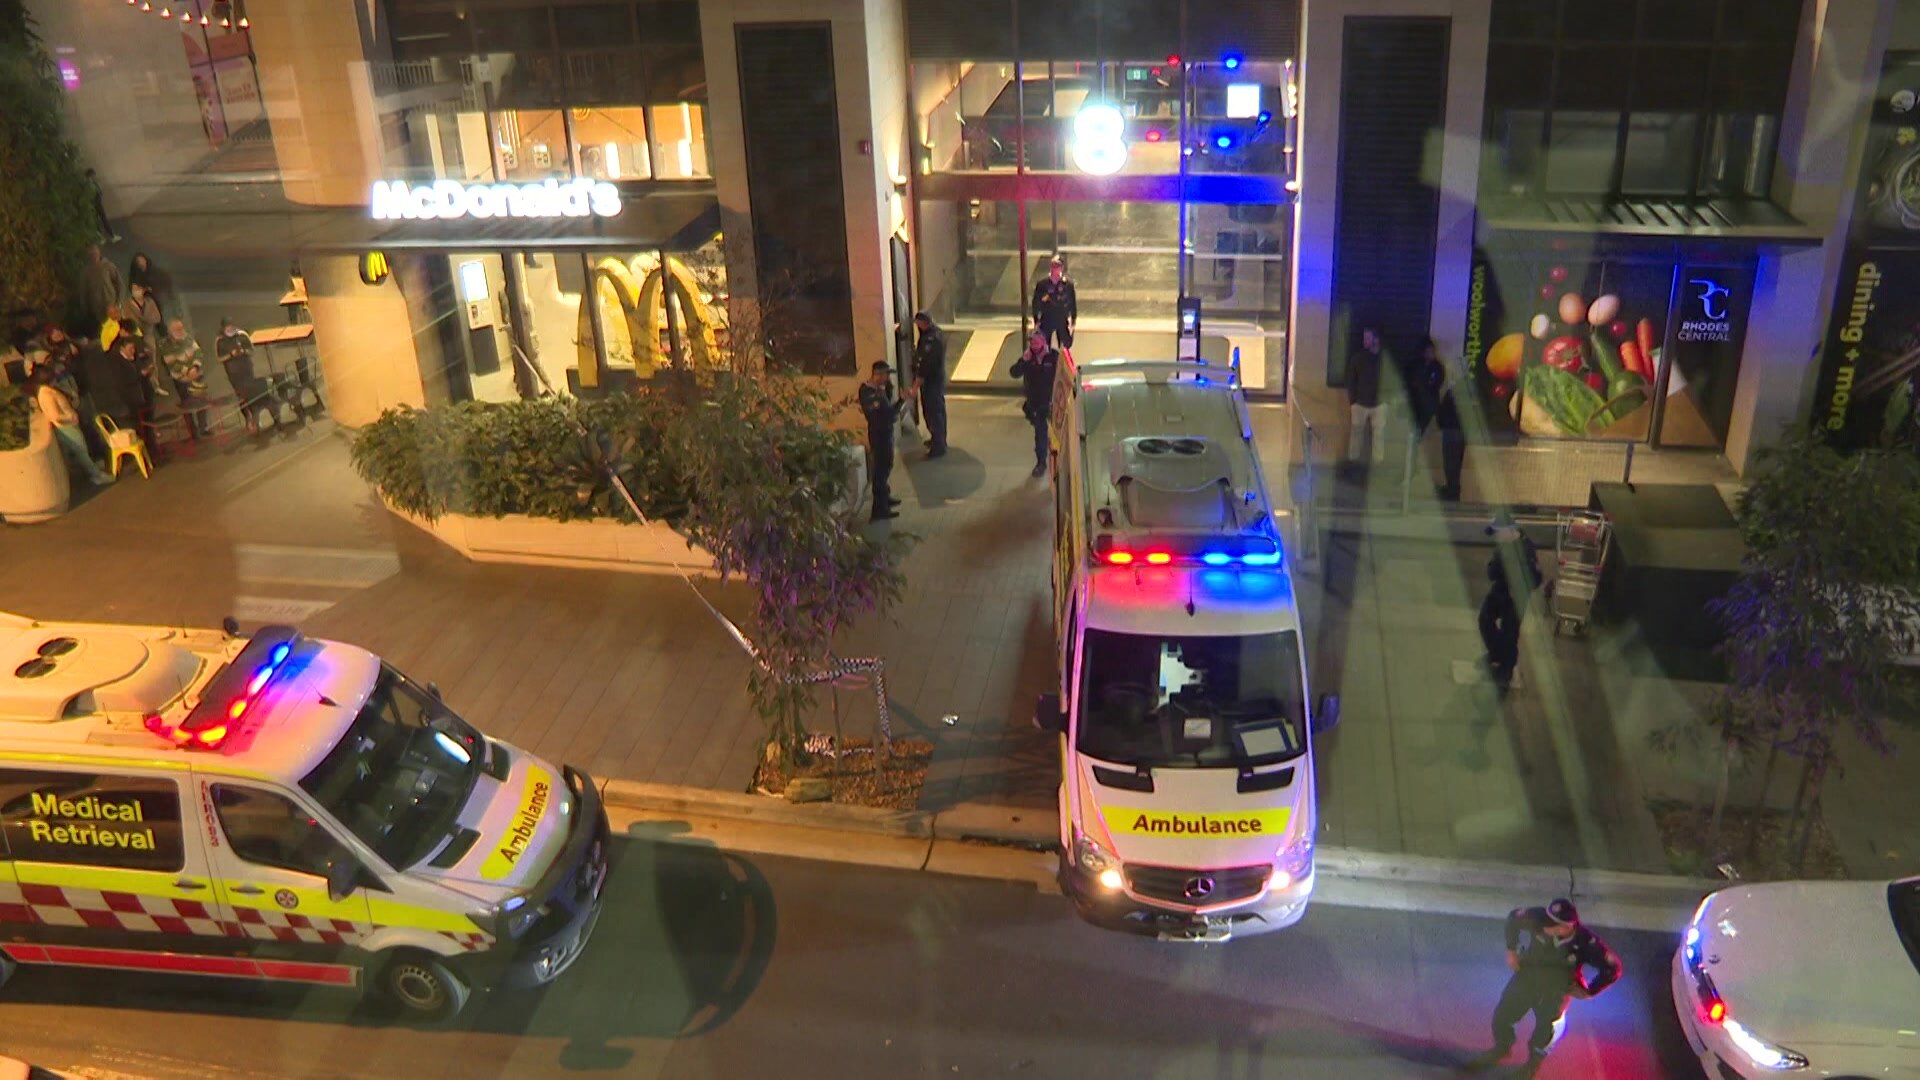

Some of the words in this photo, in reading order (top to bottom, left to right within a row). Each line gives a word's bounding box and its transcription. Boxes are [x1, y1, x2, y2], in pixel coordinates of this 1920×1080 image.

[1073, 104, 1128, 176] 8
[371, 177, 623, 220] McDonald's
[1840, 261, 1882, 343] dining
[1677, 331, 1731, 342] CENTRAL
[1682, 321, 1730, 332] RHODES
[1827, 366, 1856, 430] more
[31, 791, 143, 822] Medical
[500, 781, 549, 864] Ambulance
[1132, 814, 1263, 834] Ambulance
[30, 819, 156, 850] Retrieval
